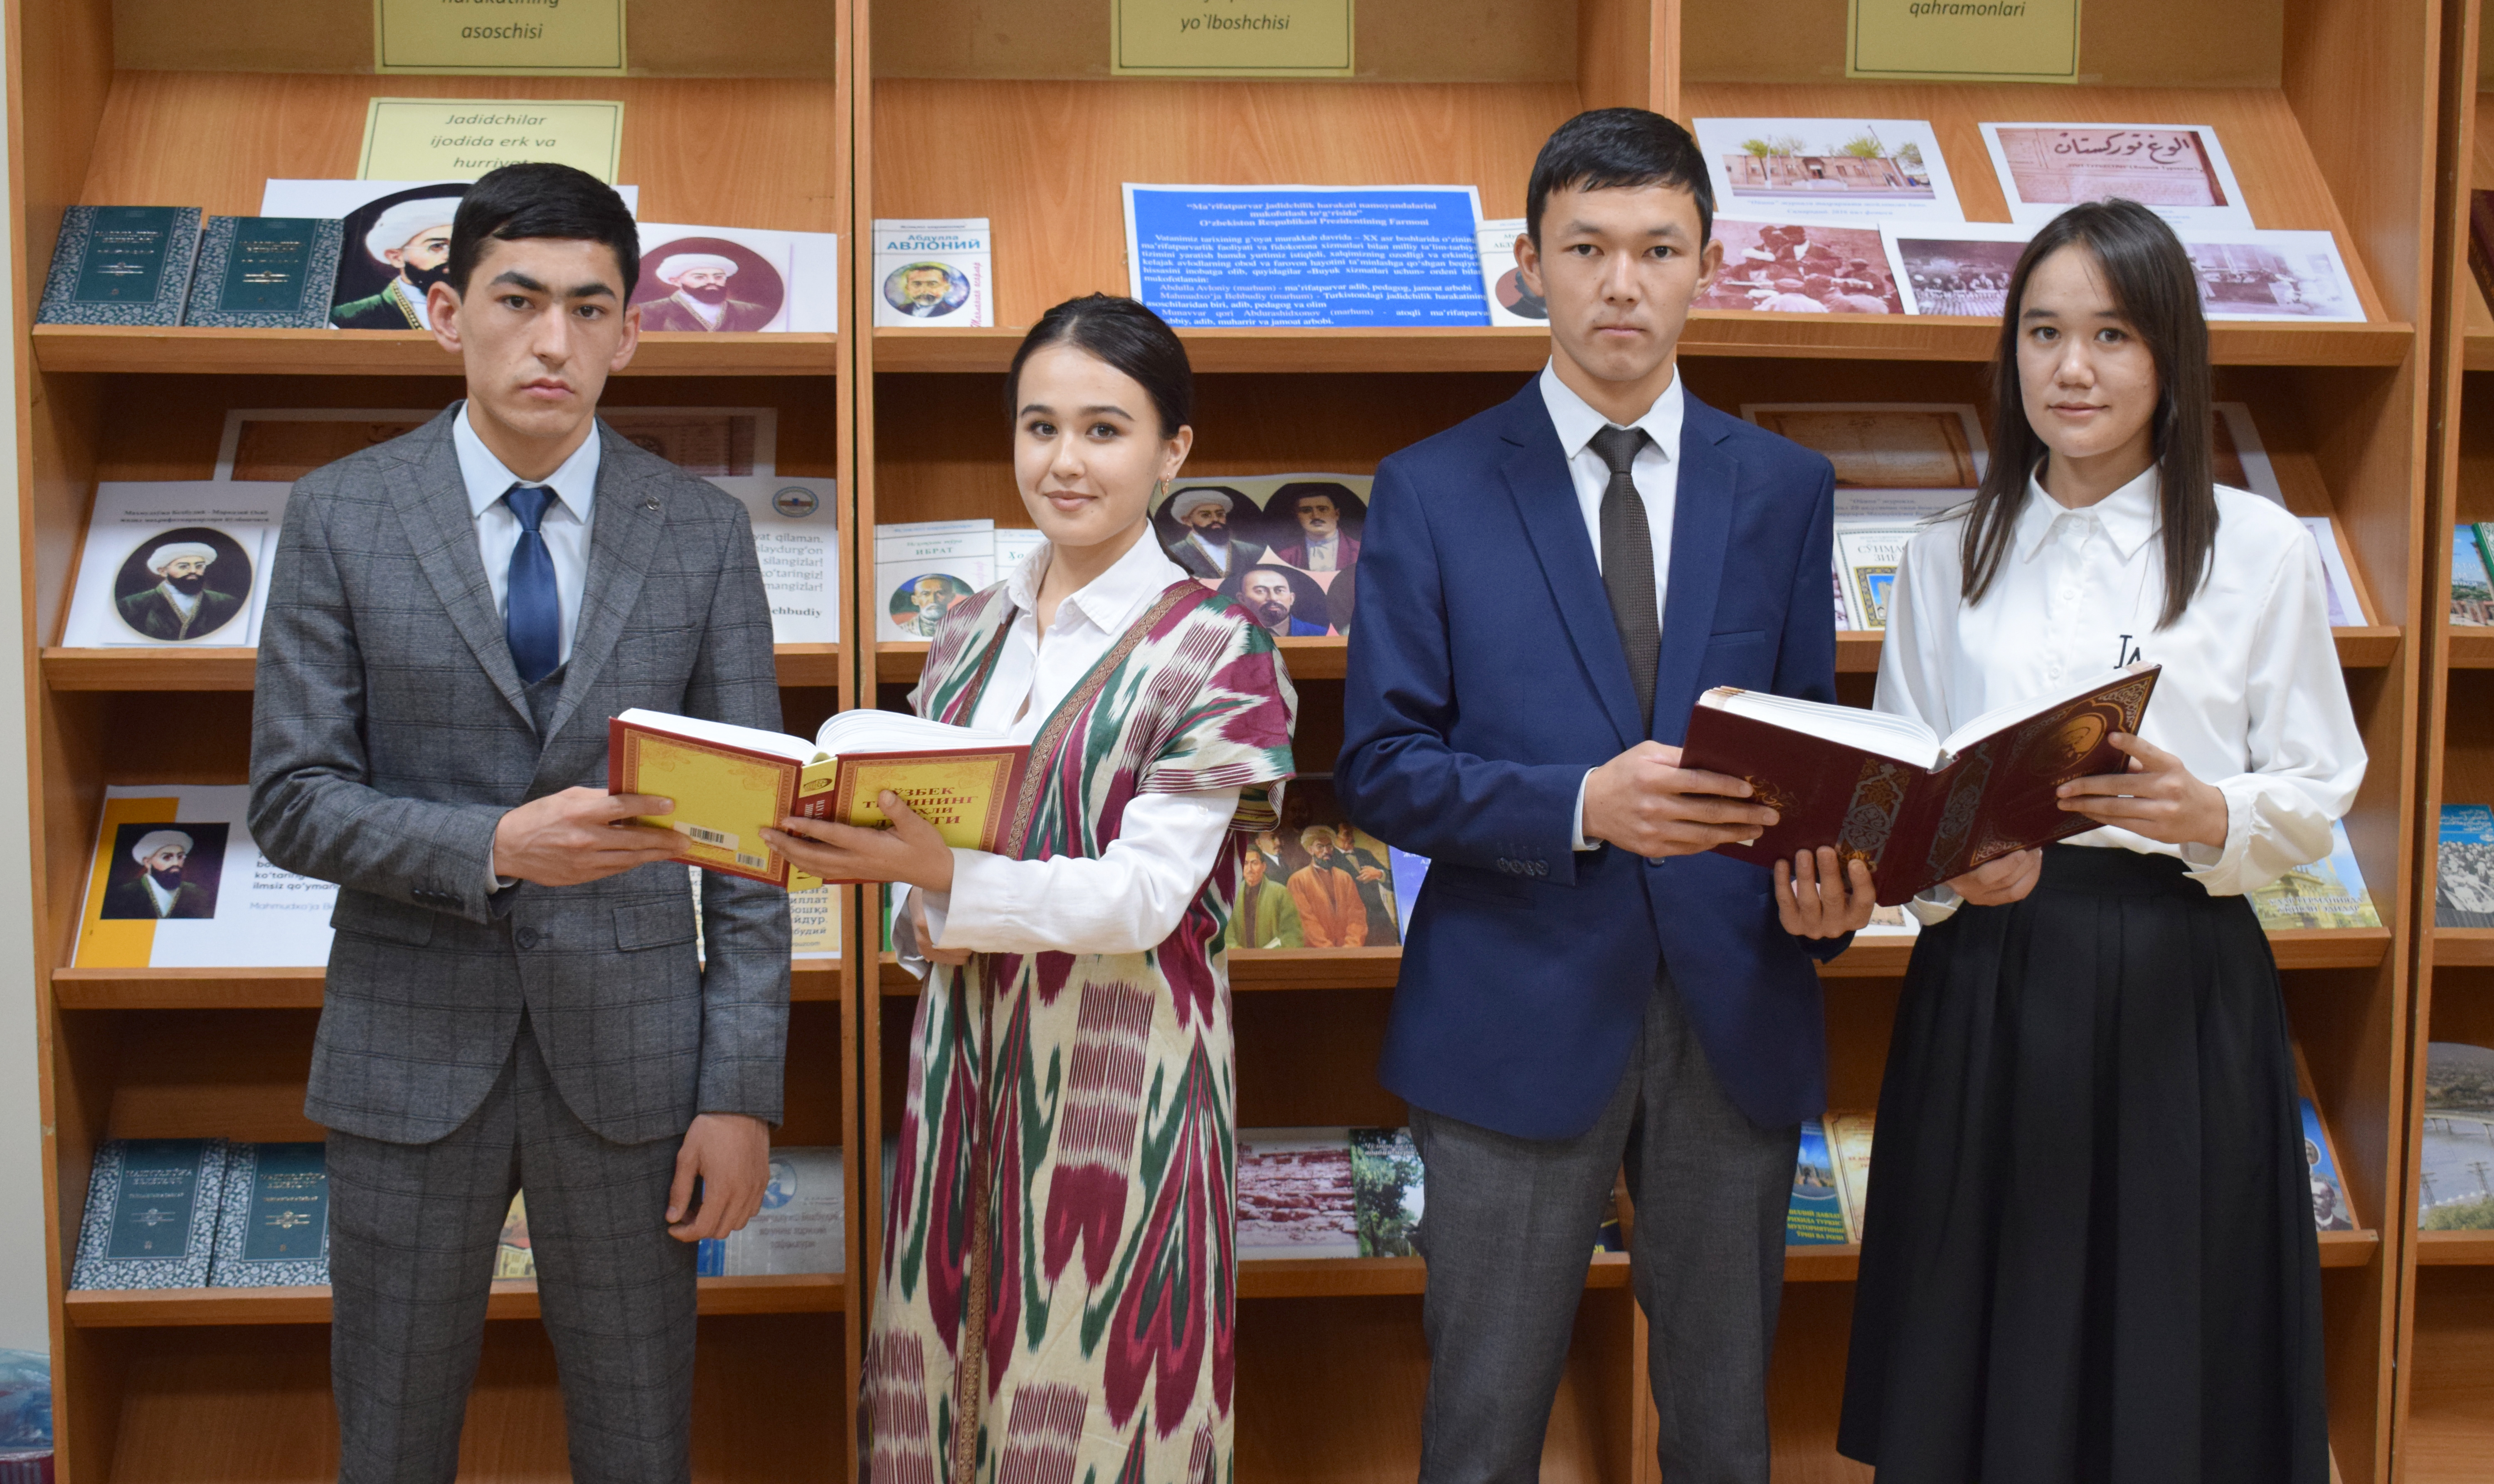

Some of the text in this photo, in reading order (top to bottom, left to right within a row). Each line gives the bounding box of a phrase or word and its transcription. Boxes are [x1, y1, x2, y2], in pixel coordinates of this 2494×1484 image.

[1910, 0, 2025, 17] qahramonlari
[461, 23, 543, 39] asoschisi
[446, 114, 547, 125] Jadidchilar
[431, 136, 494, 148] ijodida
[500, 137, 530, 146] erk
[887, 238, 980, 250] АВЛОНИЙ
[1858, 544, 1905, 553] СЎНМА
[771, 607, 822, 618] ehbudiy
[863, 796, 978, 808] ТИНИНГ
[794, 915, 828, 924] йдур.
[794, 927, 826, 937] будий
